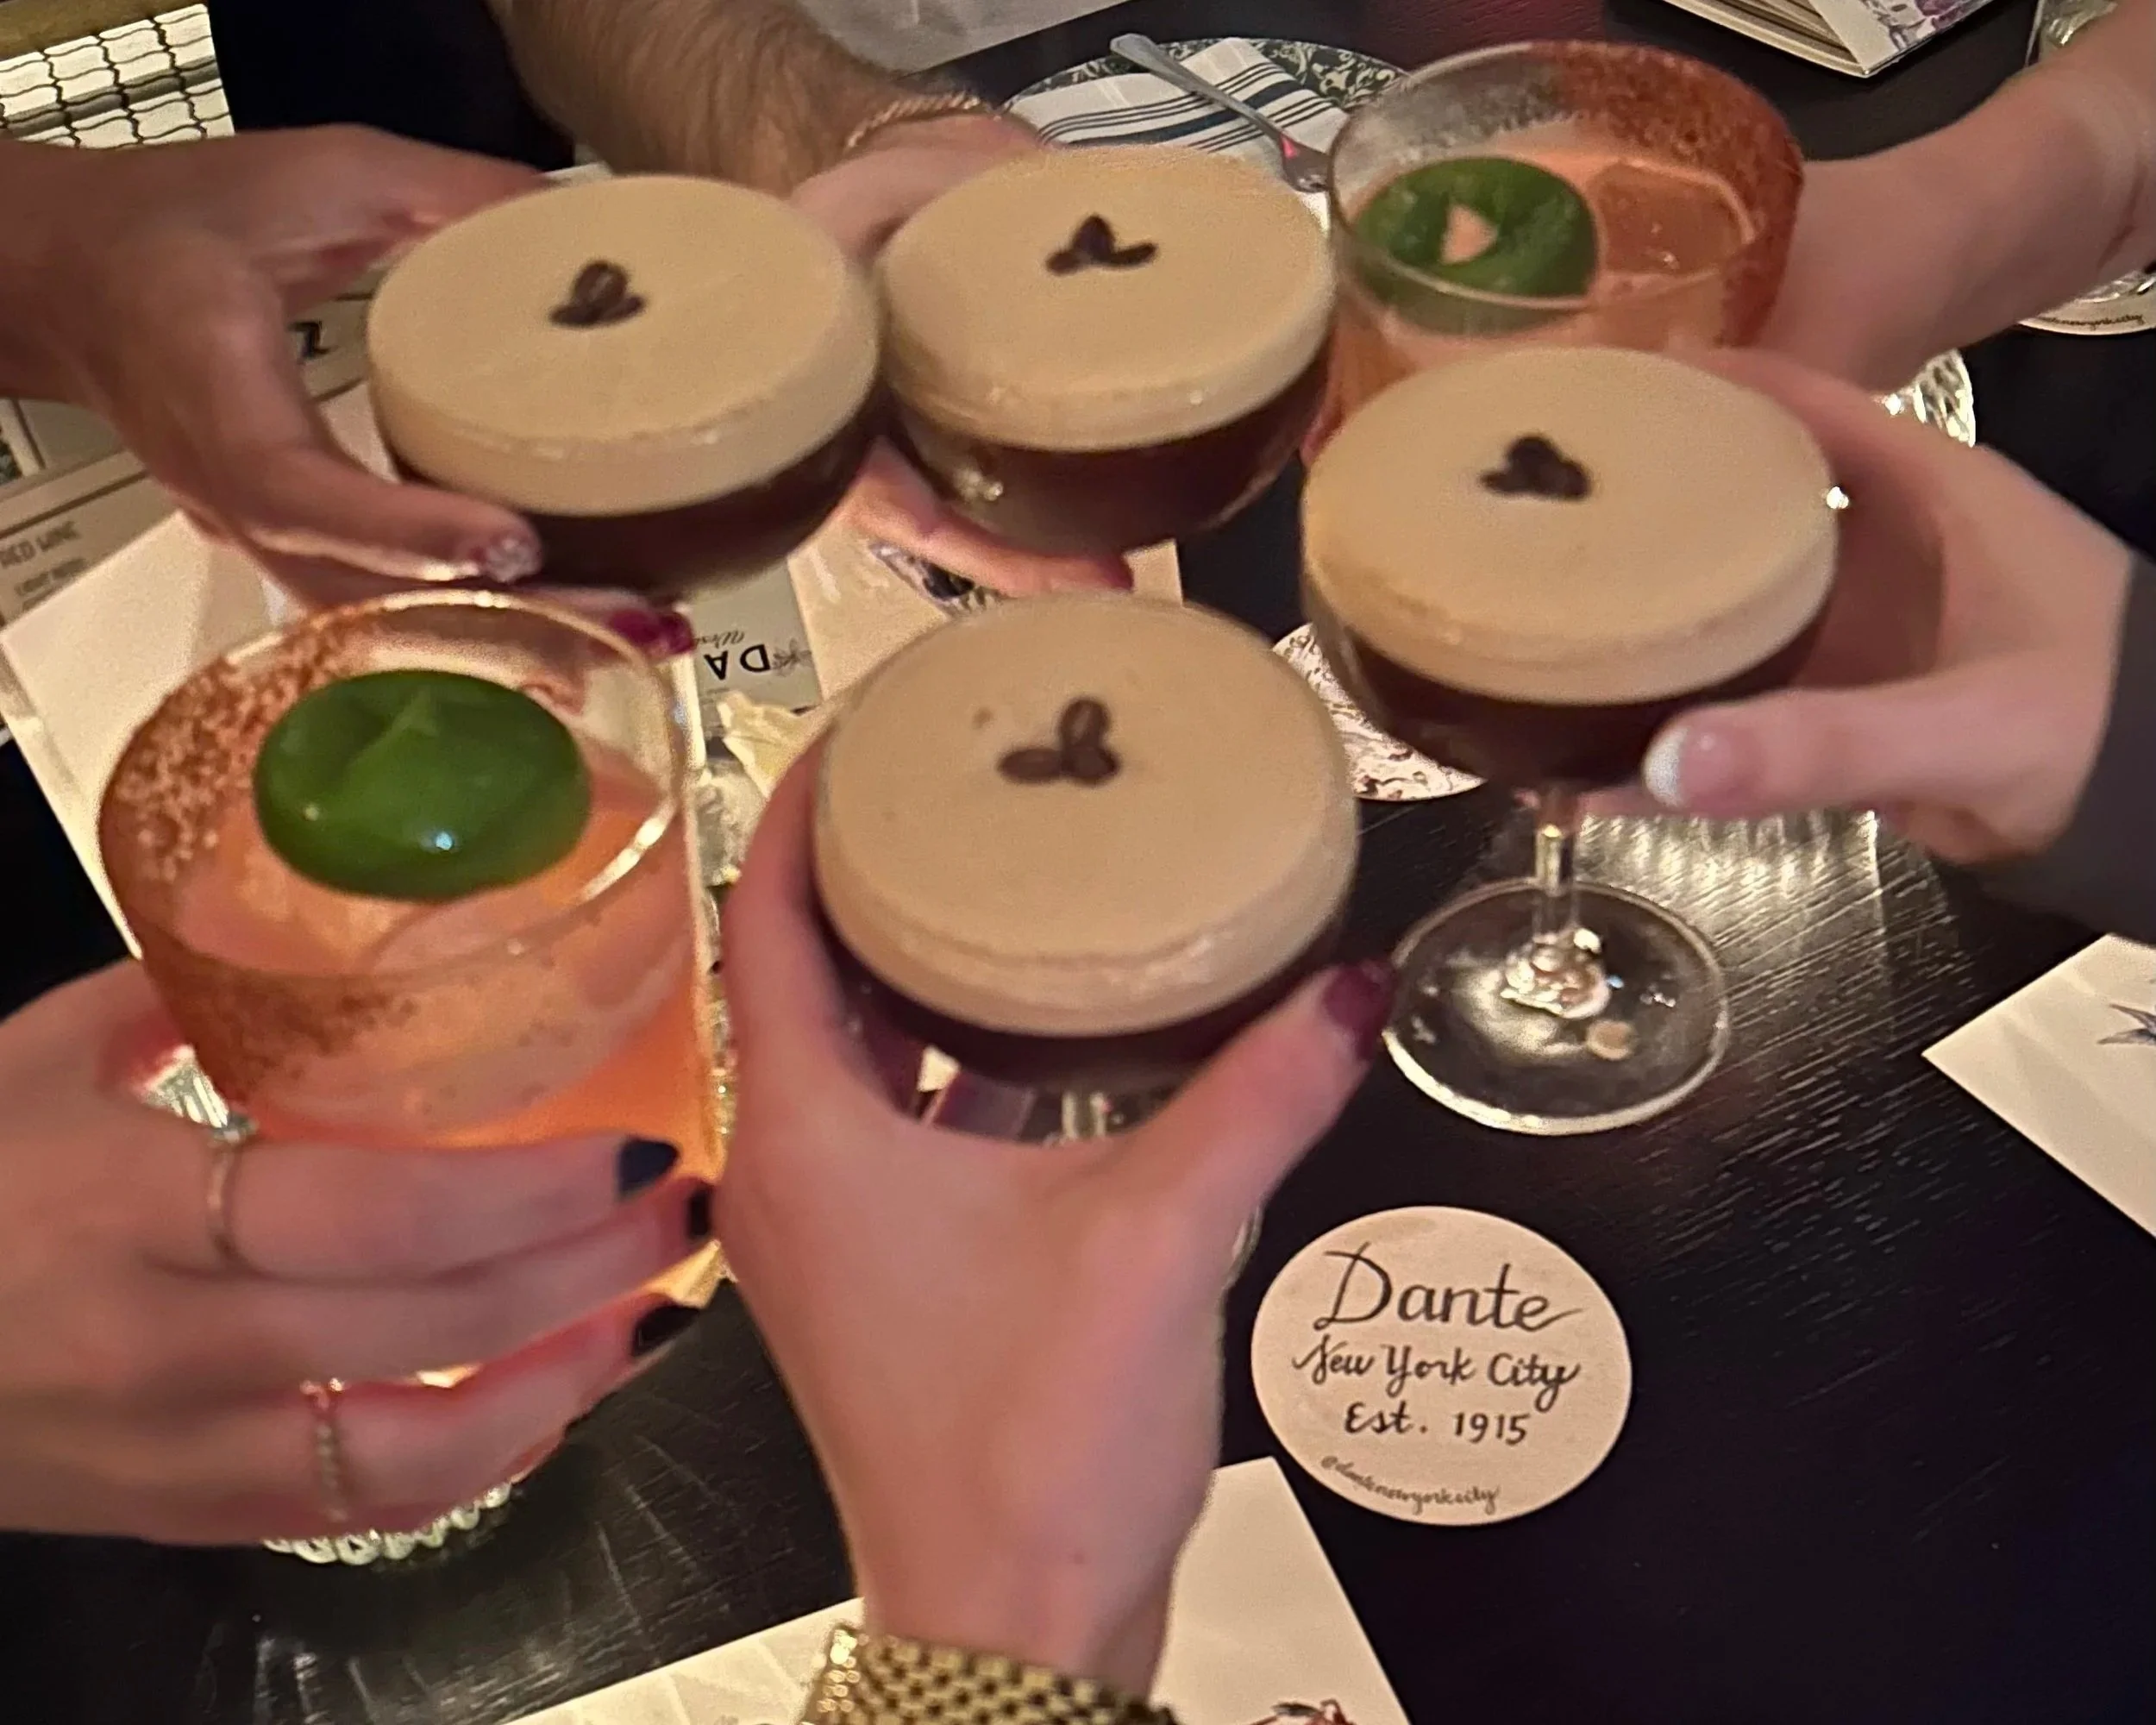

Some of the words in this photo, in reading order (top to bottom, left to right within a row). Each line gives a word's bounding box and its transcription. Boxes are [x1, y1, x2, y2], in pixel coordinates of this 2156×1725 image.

[1313, 1241, 1583, 1333] Dante
[1292, 1334, 1376, 1386] New
[1380, 1344, 1476, 1398] York
[1487, 1352, 1582, 1413] City
[1344, 1400, 1428, 1434] Est.
[1452, 1411, 1531, 1446] 1915
